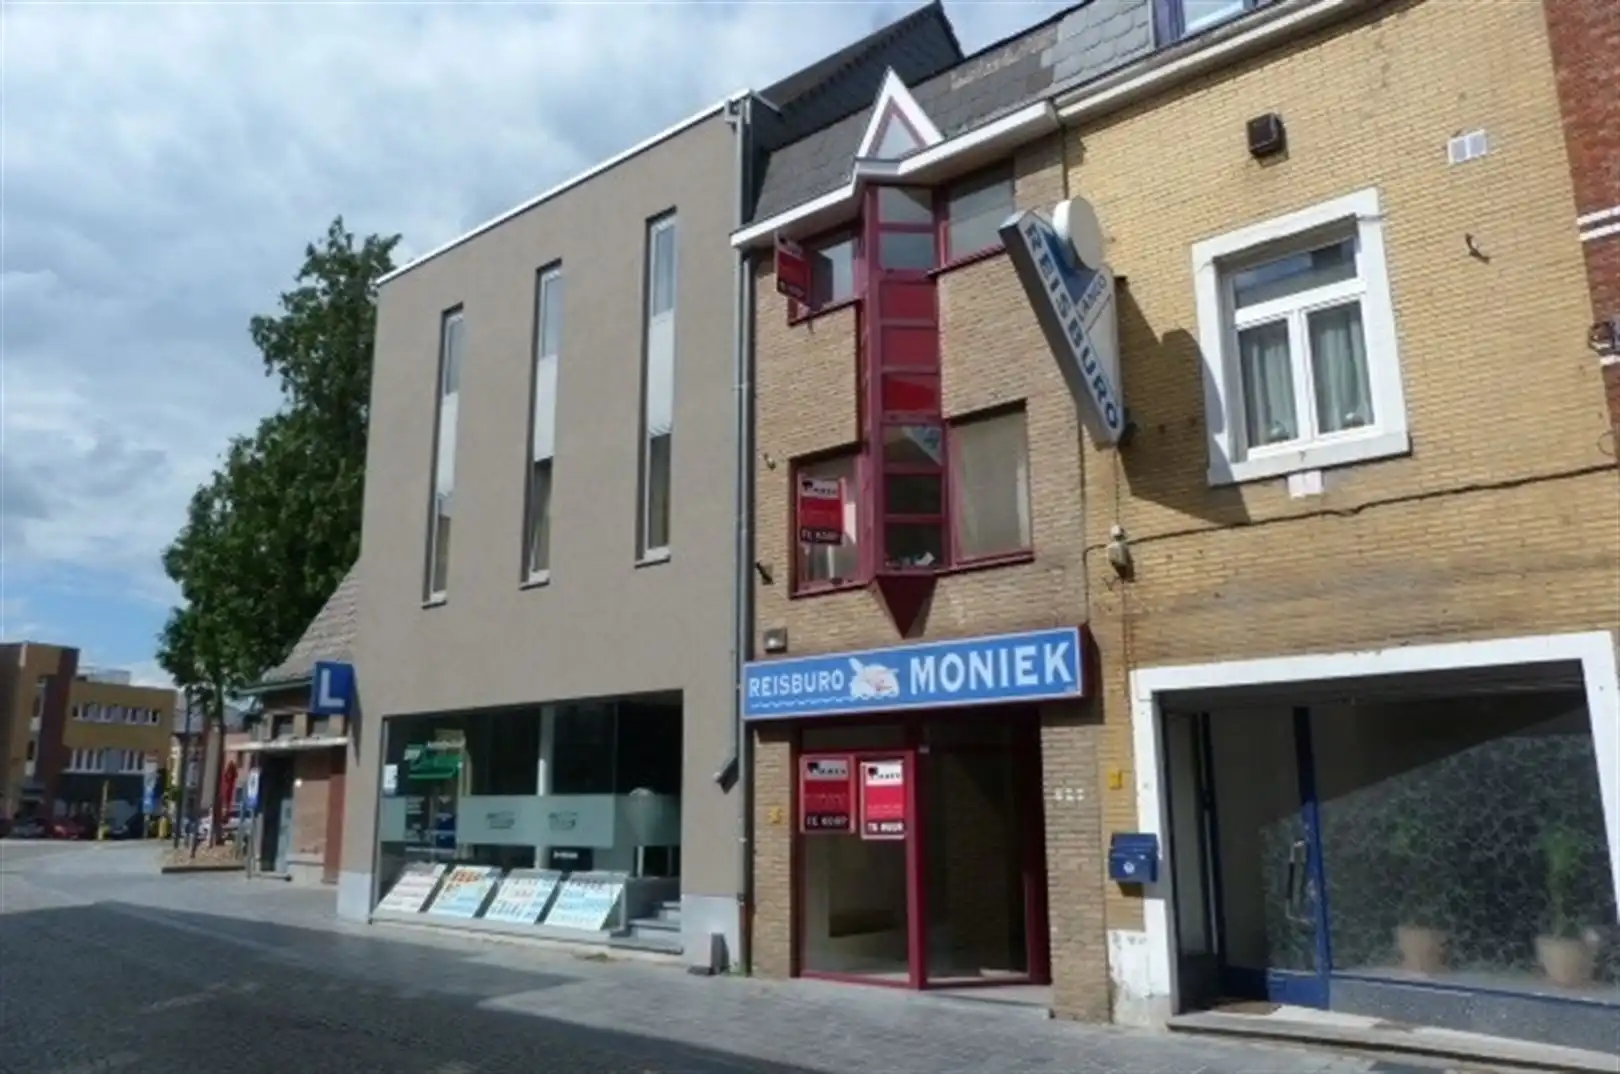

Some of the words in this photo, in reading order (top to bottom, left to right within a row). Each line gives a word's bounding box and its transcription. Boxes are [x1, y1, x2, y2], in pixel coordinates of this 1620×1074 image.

[1024, 221, 1118, 429] REISBURO
[318, 667, 346, 708] L
[749, 669, 845, 697] REISBURO
[910, 641, 1073, 695] MONIEK
